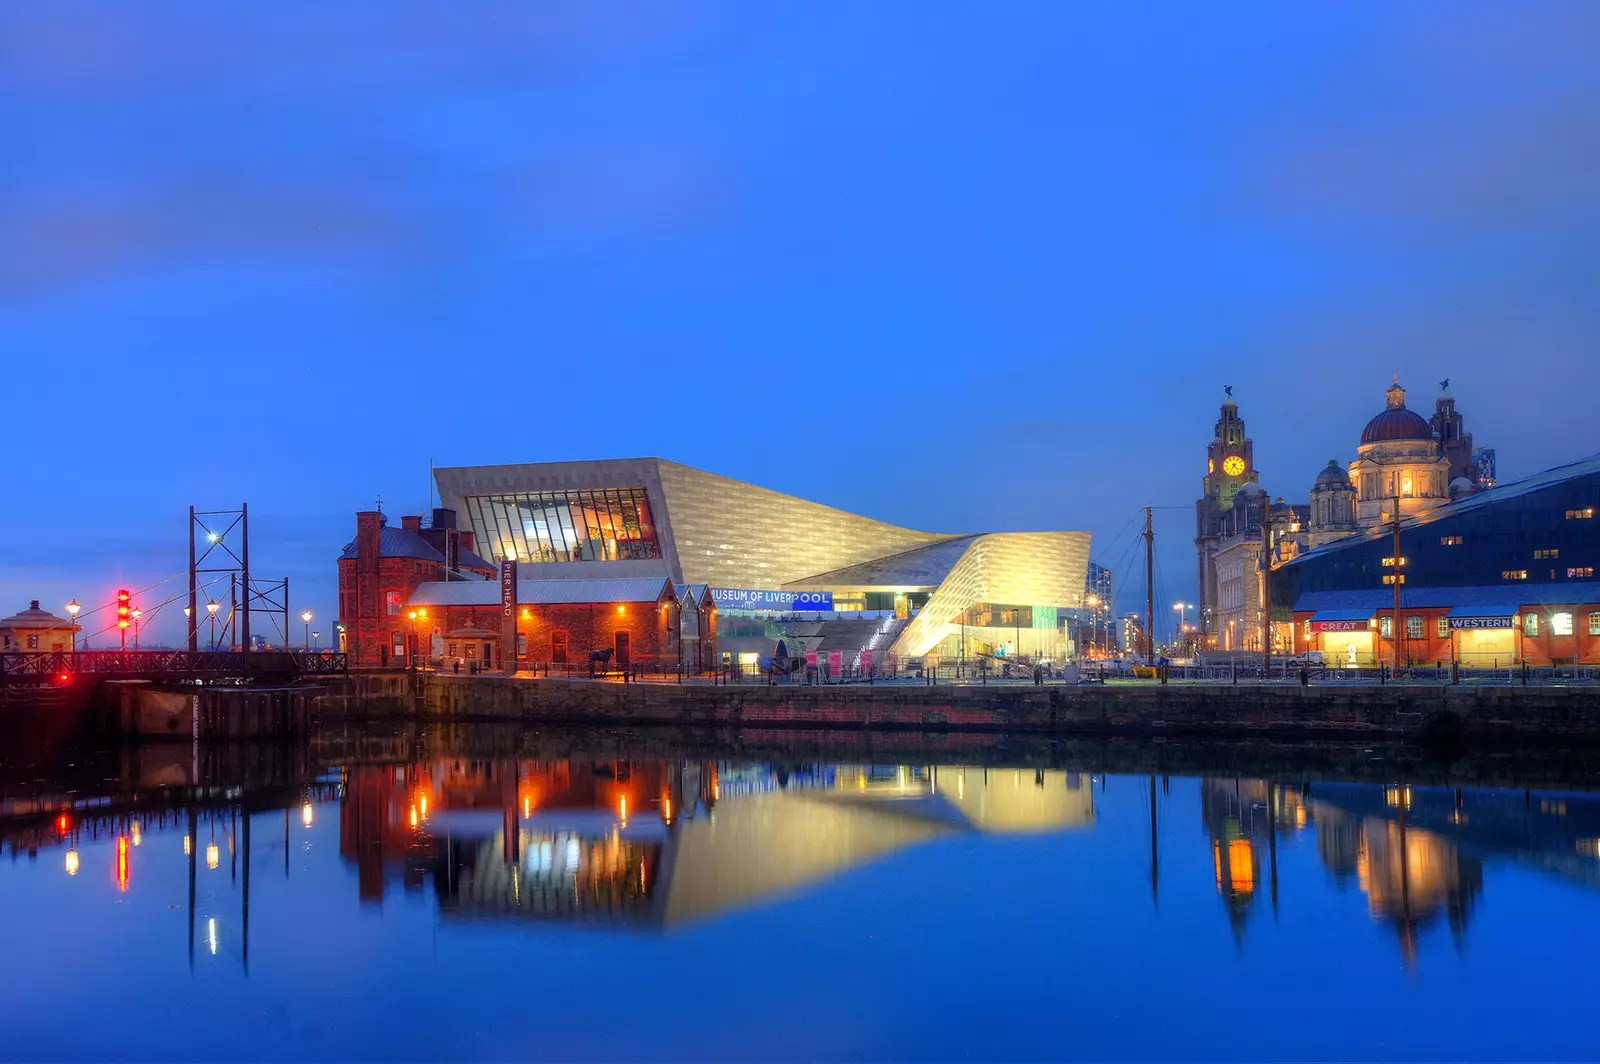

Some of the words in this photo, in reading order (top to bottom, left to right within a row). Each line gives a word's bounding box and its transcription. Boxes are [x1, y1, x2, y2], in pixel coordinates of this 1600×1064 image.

[750, 591, 763, 602] OF
[765, 592, 830, 603] LIVERPOOL
[1320, 622, 1356, 631] GREAT
[1452, 619, 1510, 628] WESTERN
